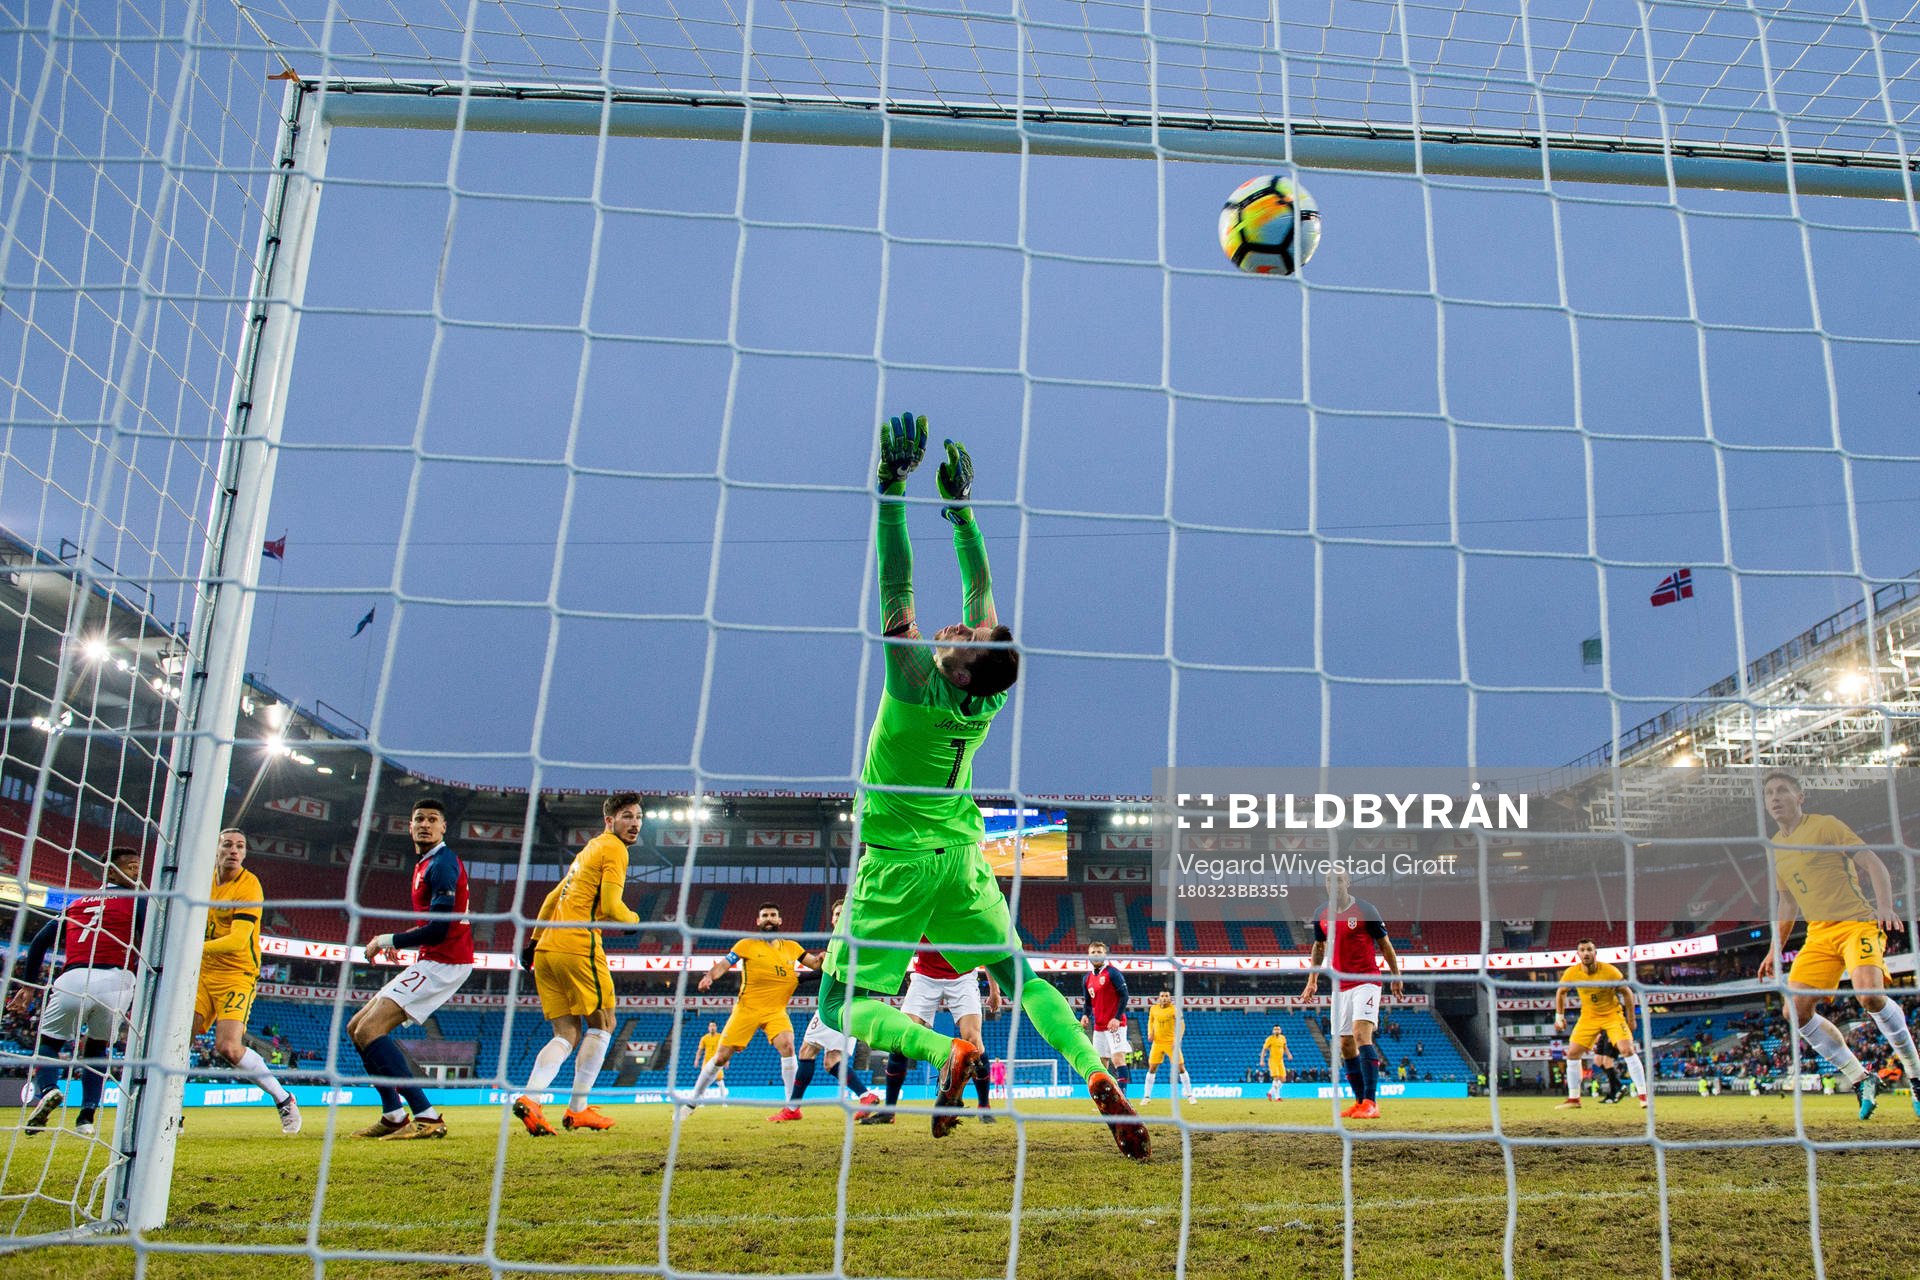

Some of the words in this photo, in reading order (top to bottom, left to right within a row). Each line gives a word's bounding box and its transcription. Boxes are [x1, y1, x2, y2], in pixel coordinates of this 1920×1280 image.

[273, 798, 324, 818] VG
[662, 830, 724, 846] VG
[753, 831, 813, 847] VG
[1106, 834, 1166, 850] VG
[1188, 835, 1245, 850] VG
[1275, 835, 1330, 850] VG
[1355, 836, 1411, 851] VG
[247, 836, 303, 858] VG
[1088, 866, 1146, 880] VG
[1793, 873, 1808, 894] 5
[78, 905, 105, 943] 7
[1089, 916, 1116, 924] VG
[1861, 937, 1873, 954] 5
[304, 944, 348, 959] VG
[646, 957, 692, 969] VG
[1044, 959, 1089, 969] VG
[1107, 959, 1152, 969] VG
[1174, 958, 1216, 969] VG
[1237, 959, 1280, 969] VG
[1424, 957, 1468, 968] VG
[1488, 954, 1533, 966] VG
[1615, 947, 1655, 960] VG
[1671, 942, 1702, 956] VG
[774, 965, 787, 977] 15
[400, 971, 427, 993] 21
[223, 991, 246, 1010] 22
[280, 986, 308, 997] VG
[472, 997, 503, 1006] VG
[627, 997, 658, 1007] VG
[702, 997, 734, 1007] VG
[1184, 997, 1213, 1005] VG
[1220, 997, 1249, 1005] VG
[1256, 996, 1285, 1005] VG
[1291, 996, 1320, 1004] VG
[1366, 996, 1374, 1008] 4
[1497, 1000, 1529, 1009] VG
[627, 1042, 656, 1051] VG
[1517, 1049, 1551, 1057] VG
[1192, 1084, 1242, 1098] oddsen
[1318, 1087, 1344, 1099] HVA
[1380, 1084, 1405, 1097] DU?
